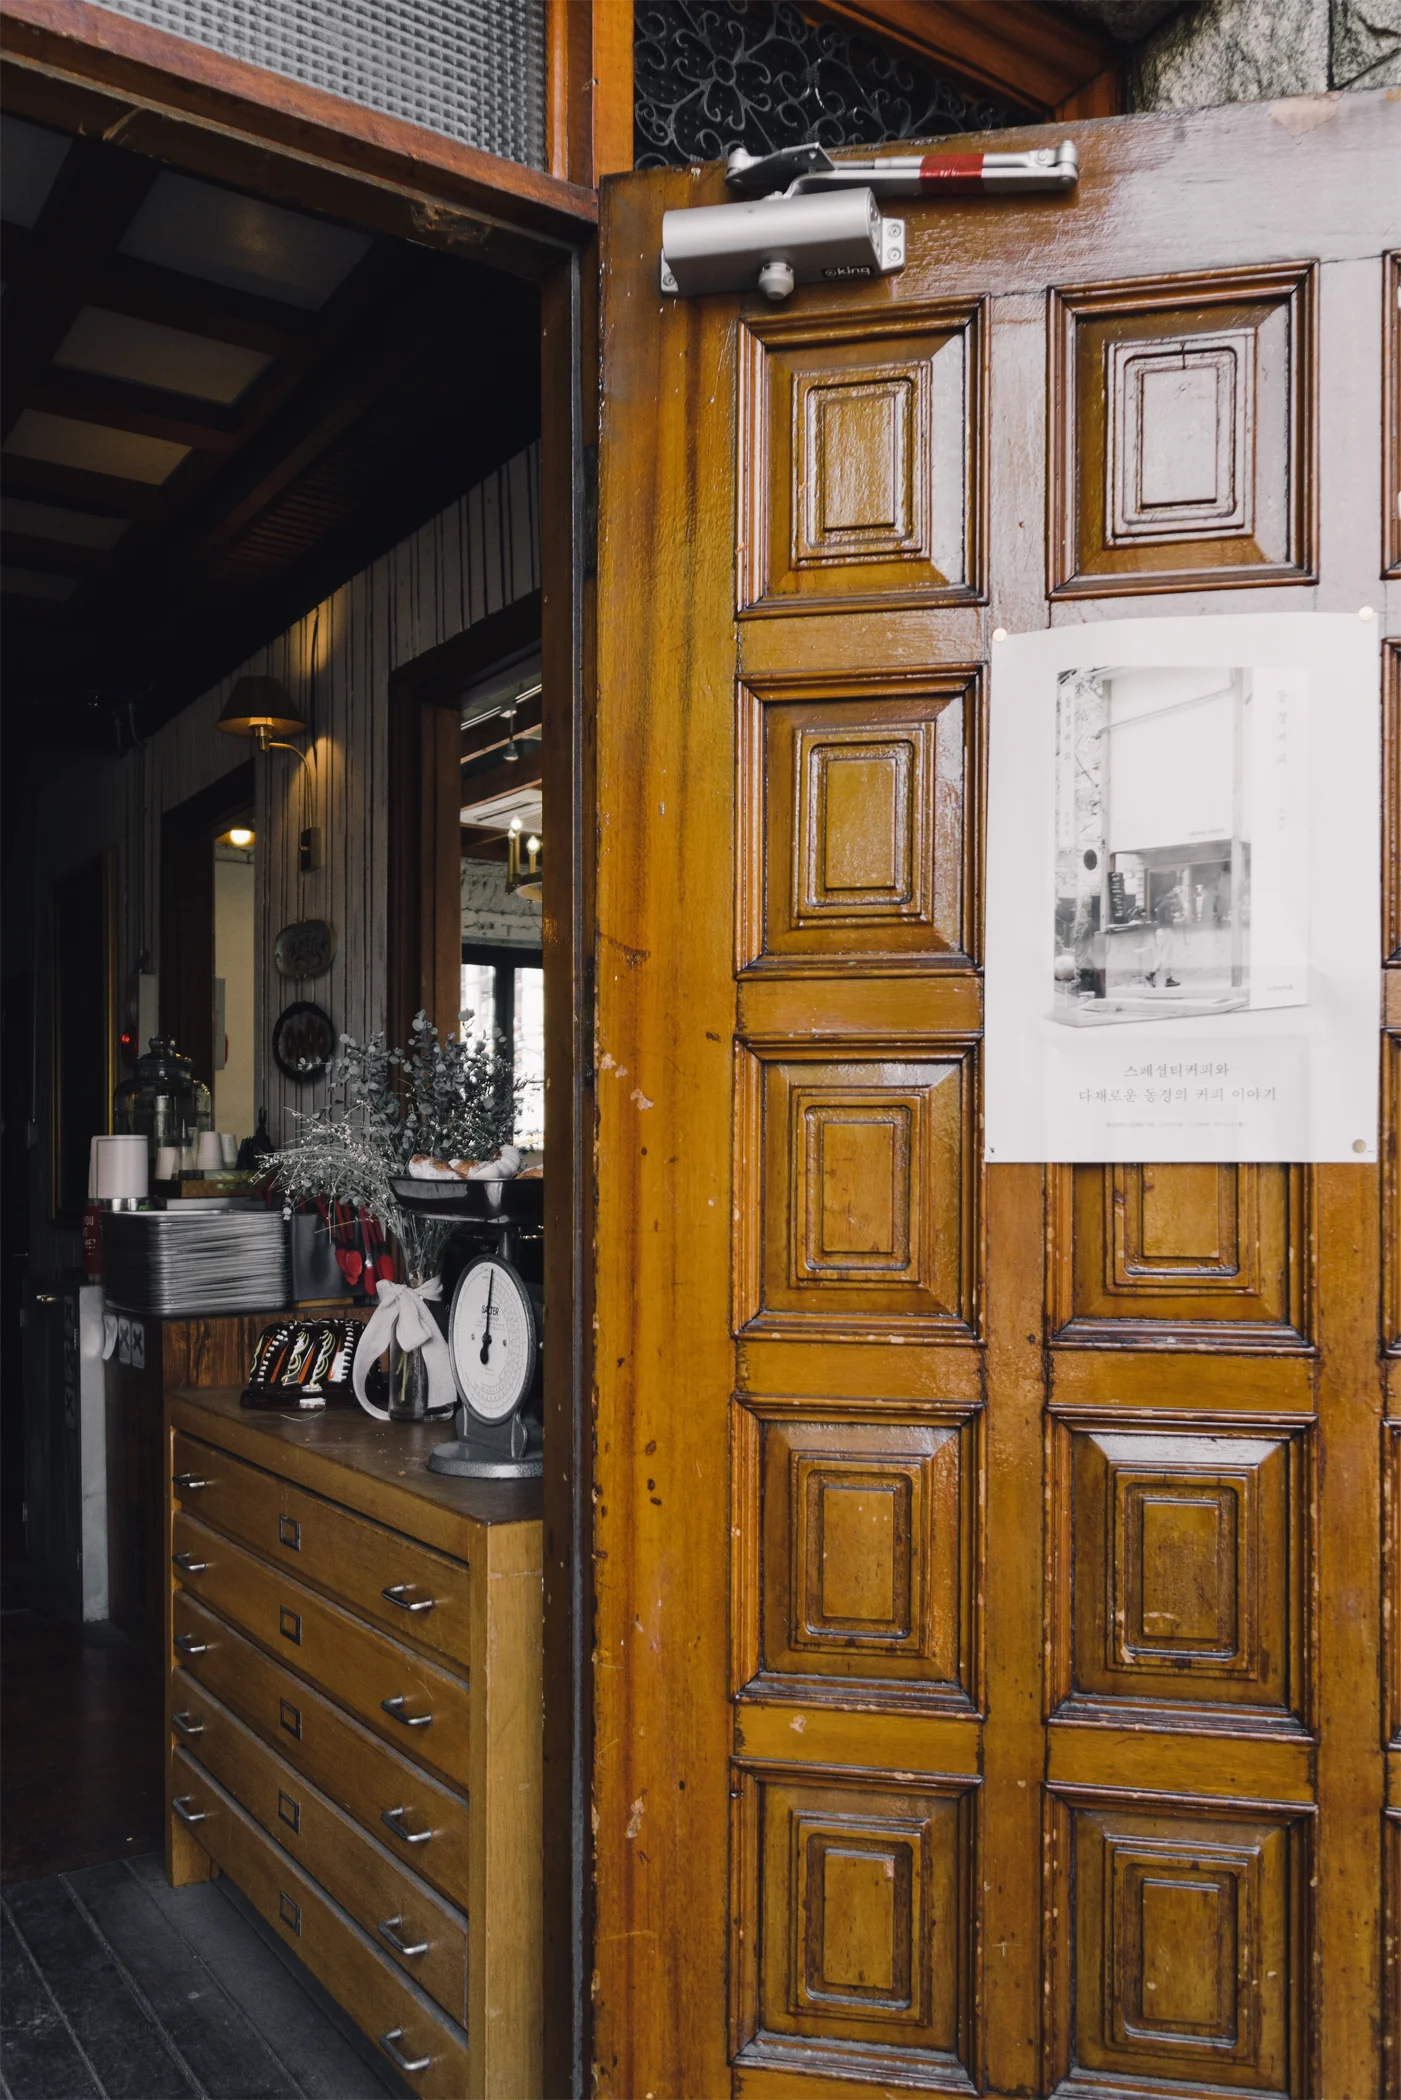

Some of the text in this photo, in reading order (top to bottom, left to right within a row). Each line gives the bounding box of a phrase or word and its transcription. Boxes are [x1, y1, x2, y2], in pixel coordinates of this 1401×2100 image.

[1078, 1086, 1277, 1103] 다채로운 동경의 커피 이야기
